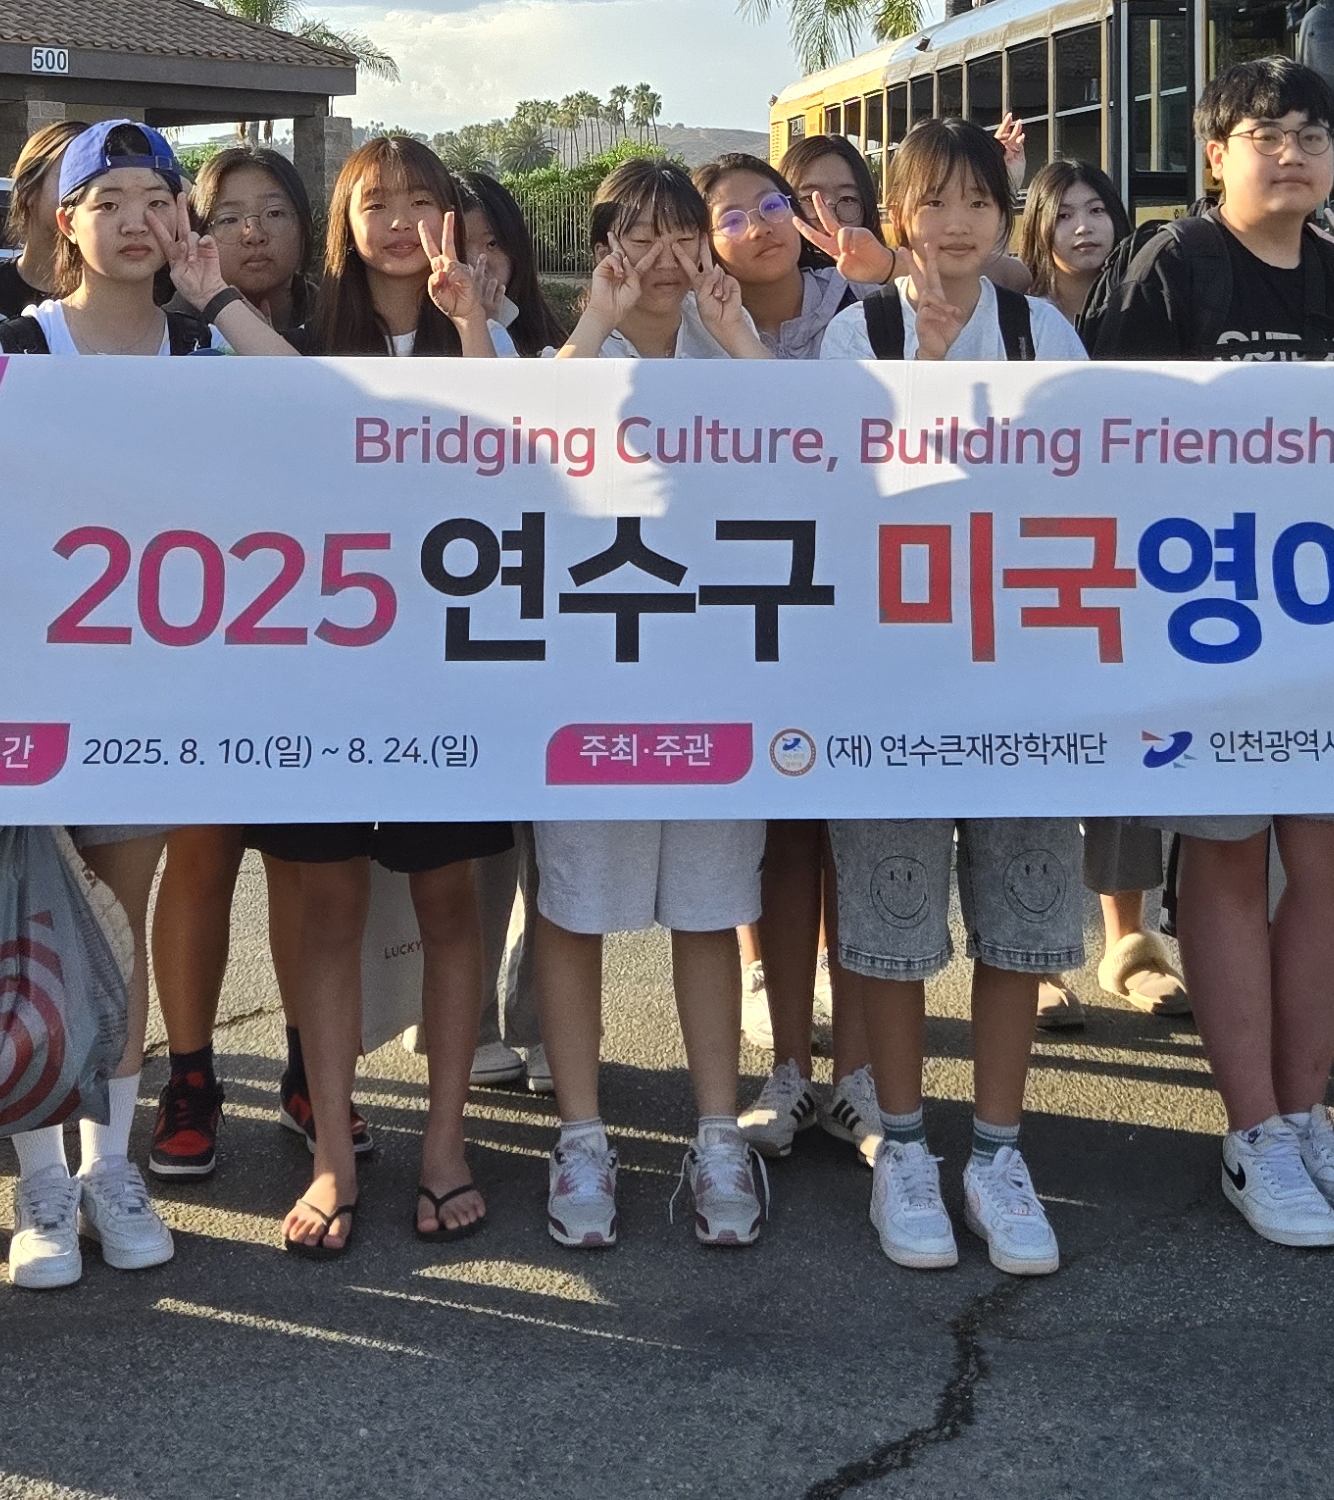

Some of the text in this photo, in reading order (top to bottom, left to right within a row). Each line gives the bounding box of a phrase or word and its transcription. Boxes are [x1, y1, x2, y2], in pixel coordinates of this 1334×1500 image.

[33, 49, 67, 70] 500
[354, 416, 597, 478] Bridging
[616, 416, 838, 473] Culture,
[859, 416, 1081, 478] Building
[82, 738, 169, 766] 2025.
[179, 738, 205, 766] 8.
[218, 735, 312, 769] 10.(일)
[383, 734, 479, 769] 24.(일)
[826, 734, 872, 769] (재)
[880, 731, 1108, 767] 연수큰재장학재단
[384, 940, 422, 959] LUCKY
